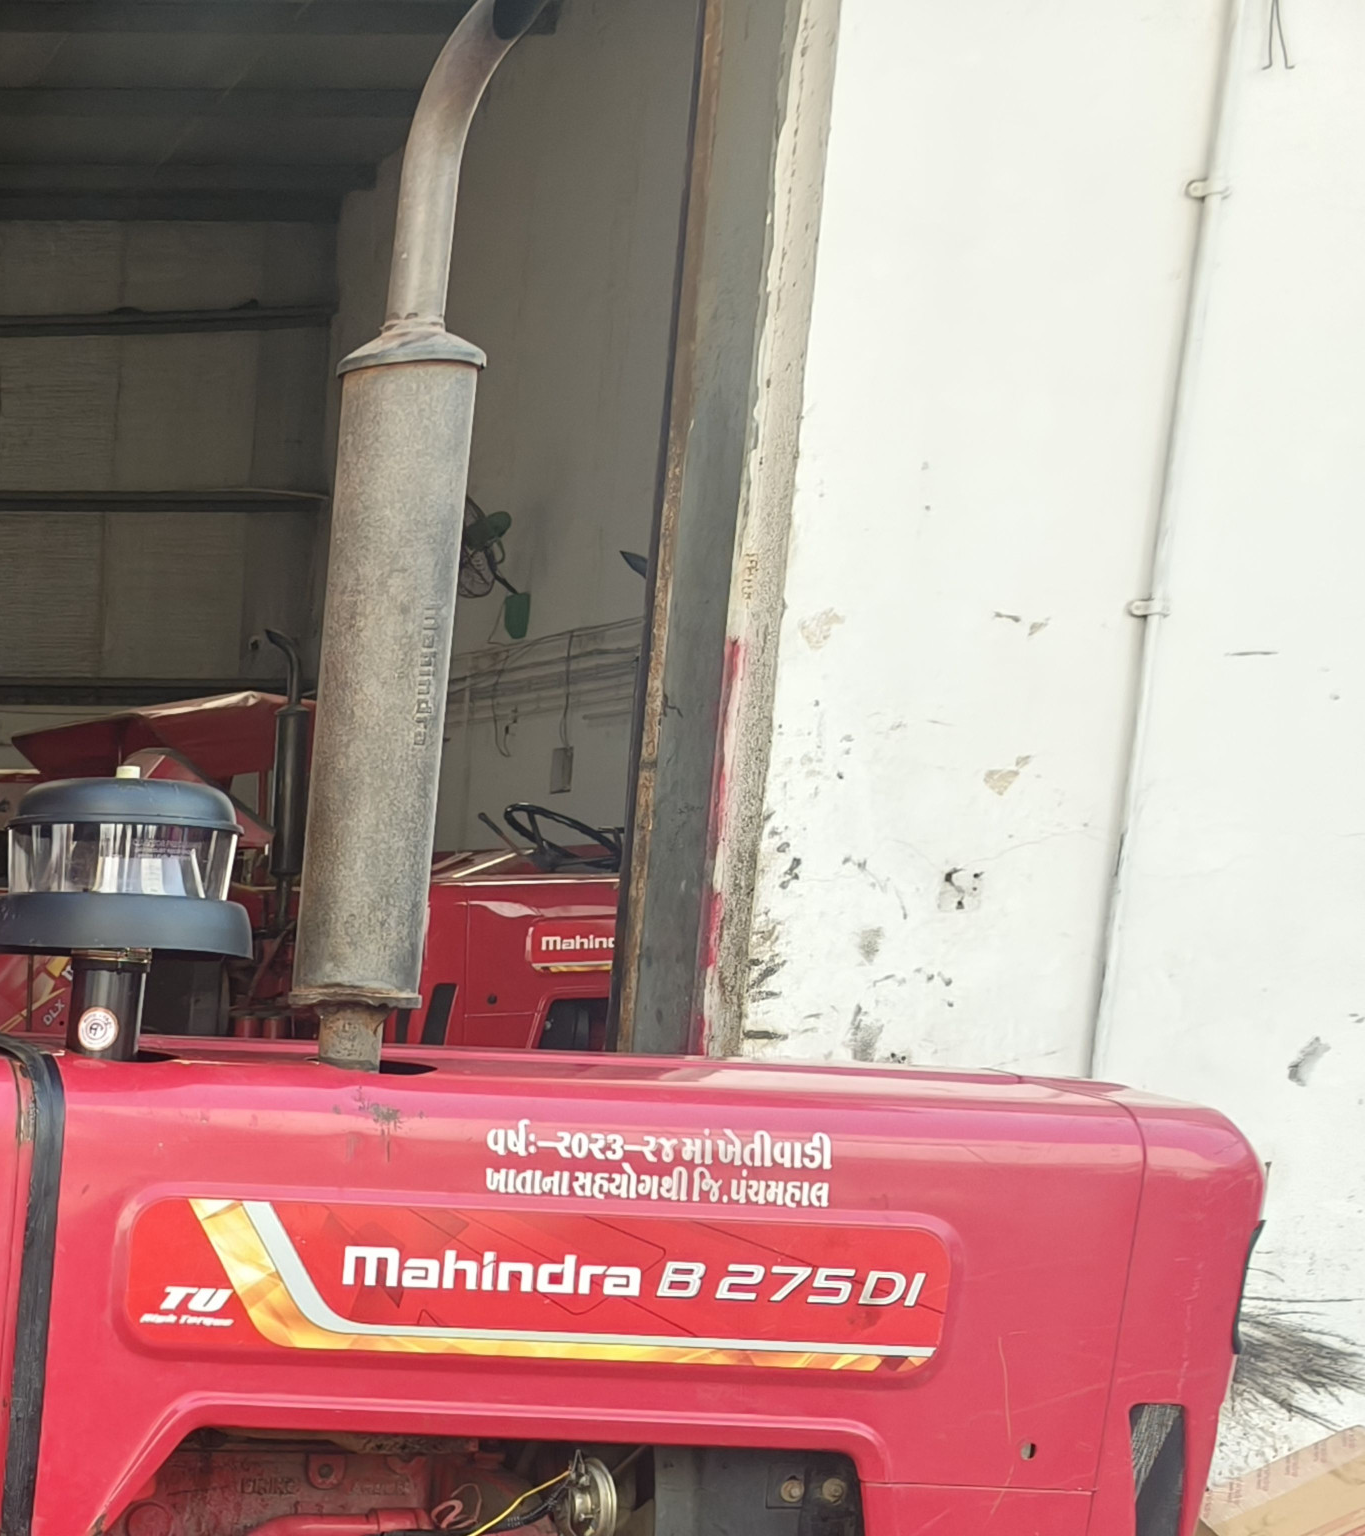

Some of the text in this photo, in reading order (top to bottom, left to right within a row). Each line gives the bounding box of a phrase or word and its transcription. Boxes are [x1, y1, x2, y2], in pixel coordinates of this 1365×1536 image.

[43, 999, 65, 1026] DLX
[485, 1167, 571, 1196] ખાતાના
[572, 1162, 688, 1201] સહયોગથી
[656, 1261, 707, 1298] B
[159, 1285, 235, 1313] TU
